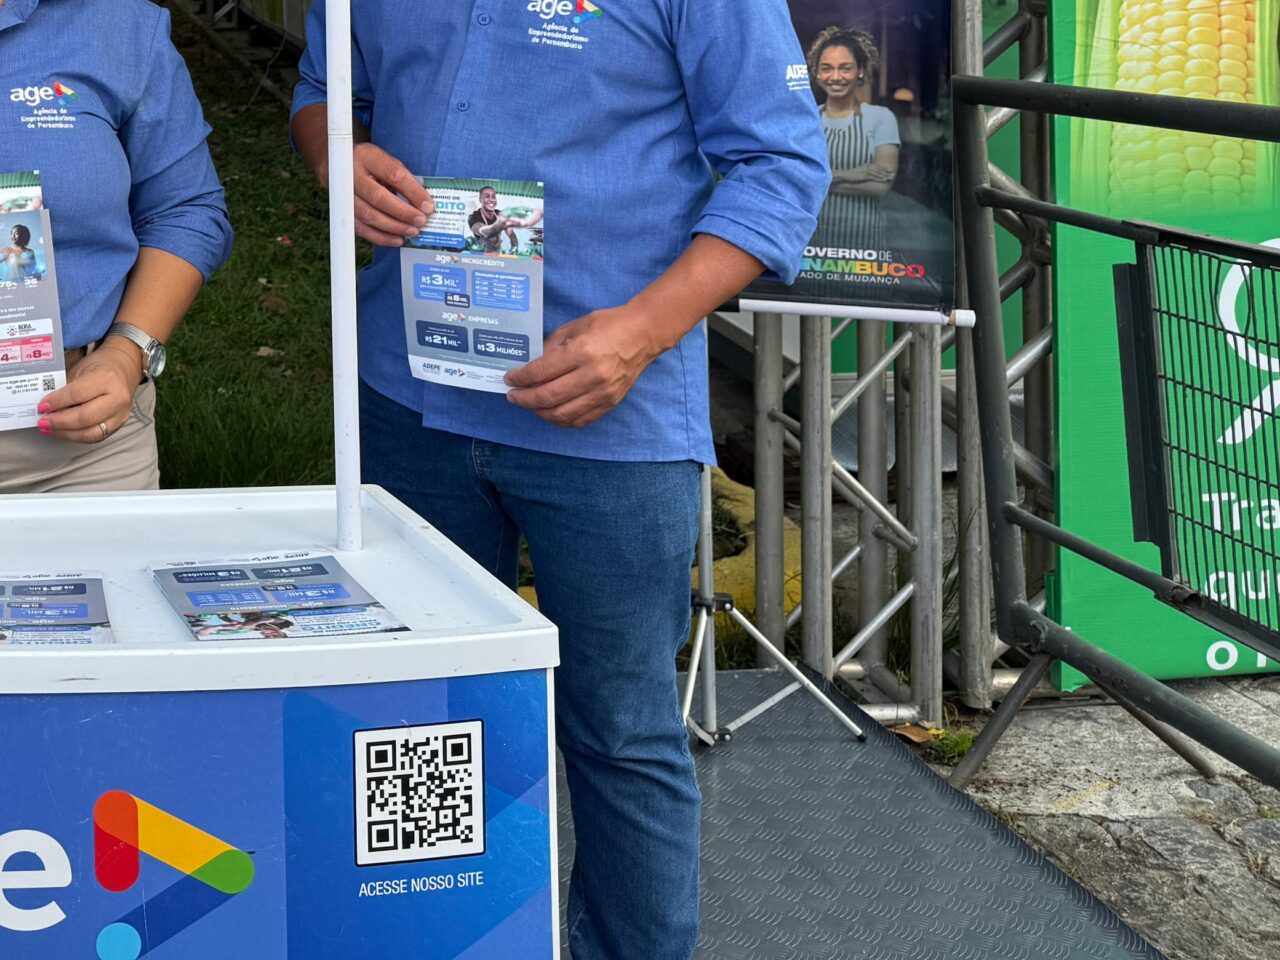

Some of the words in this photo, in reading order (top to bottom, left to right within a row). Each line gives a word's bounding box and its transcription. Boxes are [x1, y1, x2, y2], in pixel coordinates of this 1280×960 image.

[10, 86, 55, 107] age
[435, 254, 451, 264] age
[879, 250, 893, 262] DE
[421, 275, 431, 285] R$
[431, 274, 444, 286] 3
[800, 271, 823, 280] ADO
[826, 273, 841, 281] DE
[844, 274, 901, 285] MUDANÇA
[441, 311, 458, 321] age
[432, 334, 448, 345] 21
[485, 342, 496, 353] 3
[0, 353, 10, 362] 4
[358, 878, 408, 898] ACESSE
[411, 874, 455, 893] NOSSO
[457, 871, 484, 888] SITE
